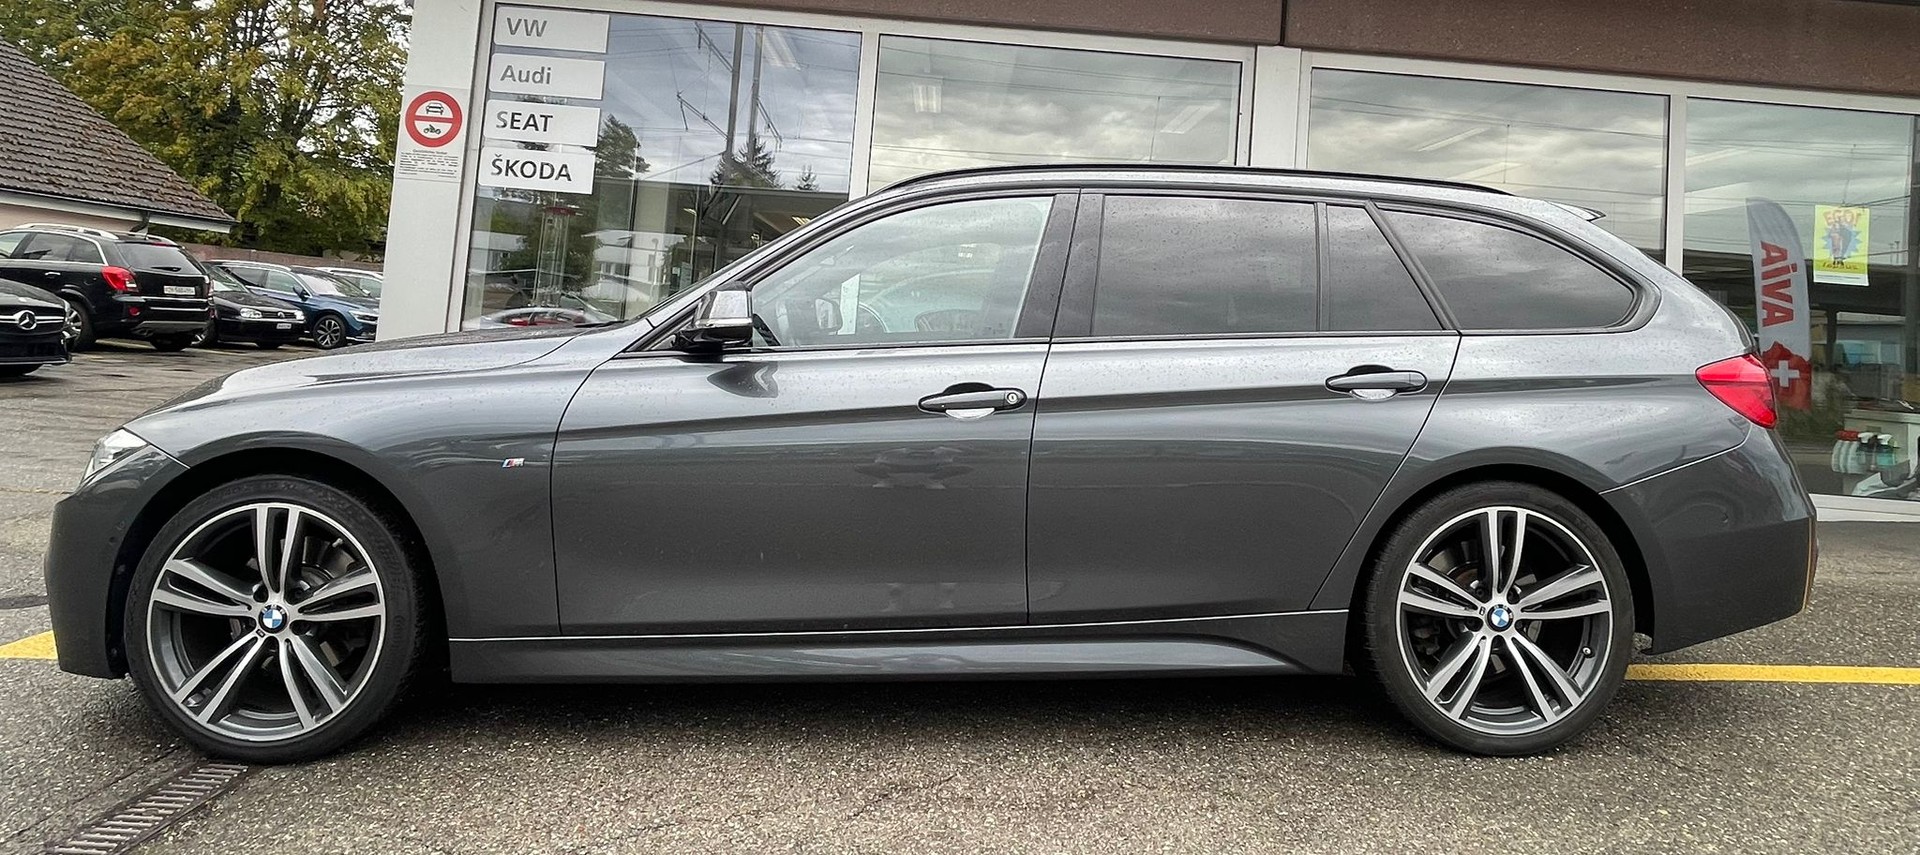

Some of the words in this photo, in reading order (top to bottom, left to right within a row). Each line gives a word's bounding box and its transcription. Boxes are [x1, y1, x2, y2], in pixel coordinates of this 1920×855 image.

[506, 17, 548, 38] VW
[500, 64, 552, 85] Audi
[495, 111, 554, 133] SEAT
[491, 153, 572, 182] ŠKODA
